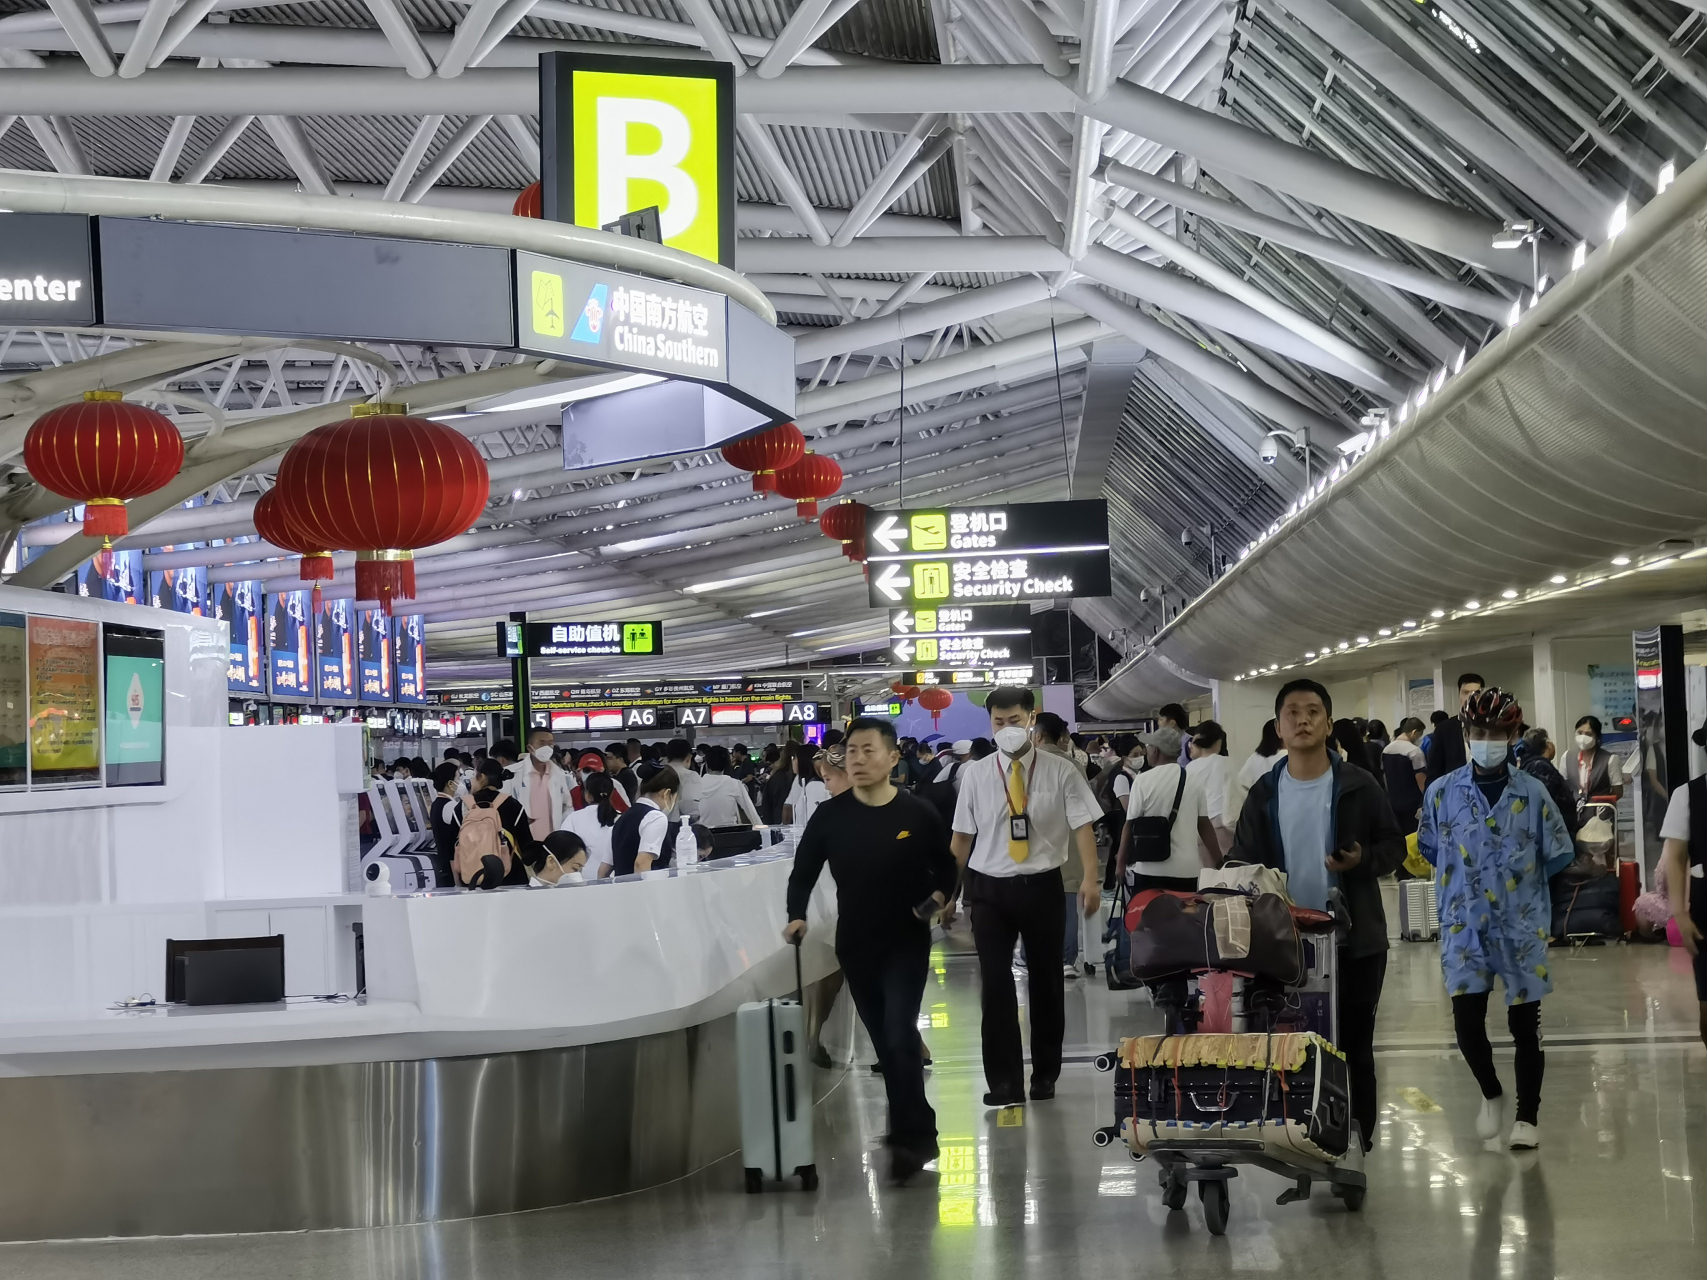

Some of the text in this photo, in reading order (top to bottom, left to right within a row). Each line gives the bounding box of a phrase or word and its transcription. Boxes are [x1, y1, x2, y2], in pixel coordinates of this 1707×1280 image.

[597, 96, 699, 240] B
[0, 275, 81, 301] enter
[612, 286, 709, 336] 中国南方航空
[614, 325, 719, 368] China Southern
[950, 512, 1007, 533] 登机口
[951, 534, 996, 549] Gates
[953, 559, 1027, 581] 安全检查
[953, 576, 1073, 597] Security Check
[938, 609, 973, 622] 登机口
[552, 625, 620, 642] 自助值机
[938, 622, 966, 632] Gates
[540, 646, 620, 655] Self-service check-in
[940, 638, 984, 650] 安全检查
[940, 647, 1010, 661] Security Check
[531, 713, 547, 729] 5
[627, 708, 654, 726] A6
[681, 708, 707, 724] A7
[788, 704, 815, 721] A8
